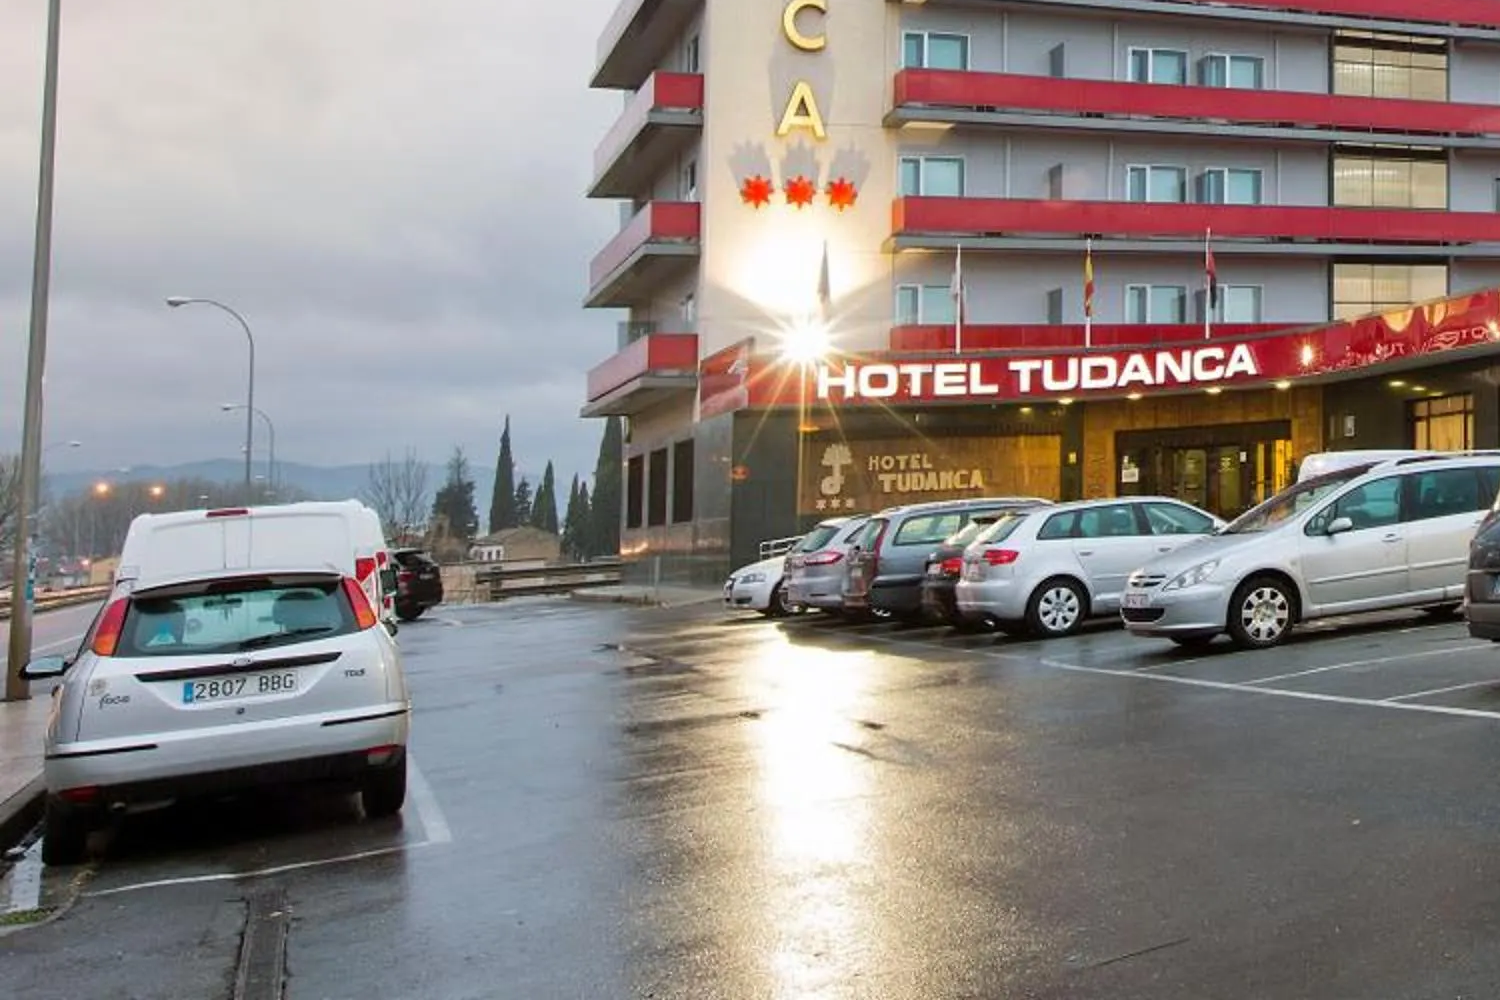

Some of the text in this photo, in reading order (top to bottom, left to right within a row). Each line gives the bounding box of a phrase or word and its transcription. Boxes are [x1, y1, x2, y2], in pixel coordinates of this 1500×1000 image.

[817, 344, 1257, 398] HOTEL TUDANCA
[868, 454, 932, 471] HOTEL
[878, 469, 984, 493] TUDANCA
[195, 673, 294, 700] 2807 BBG
